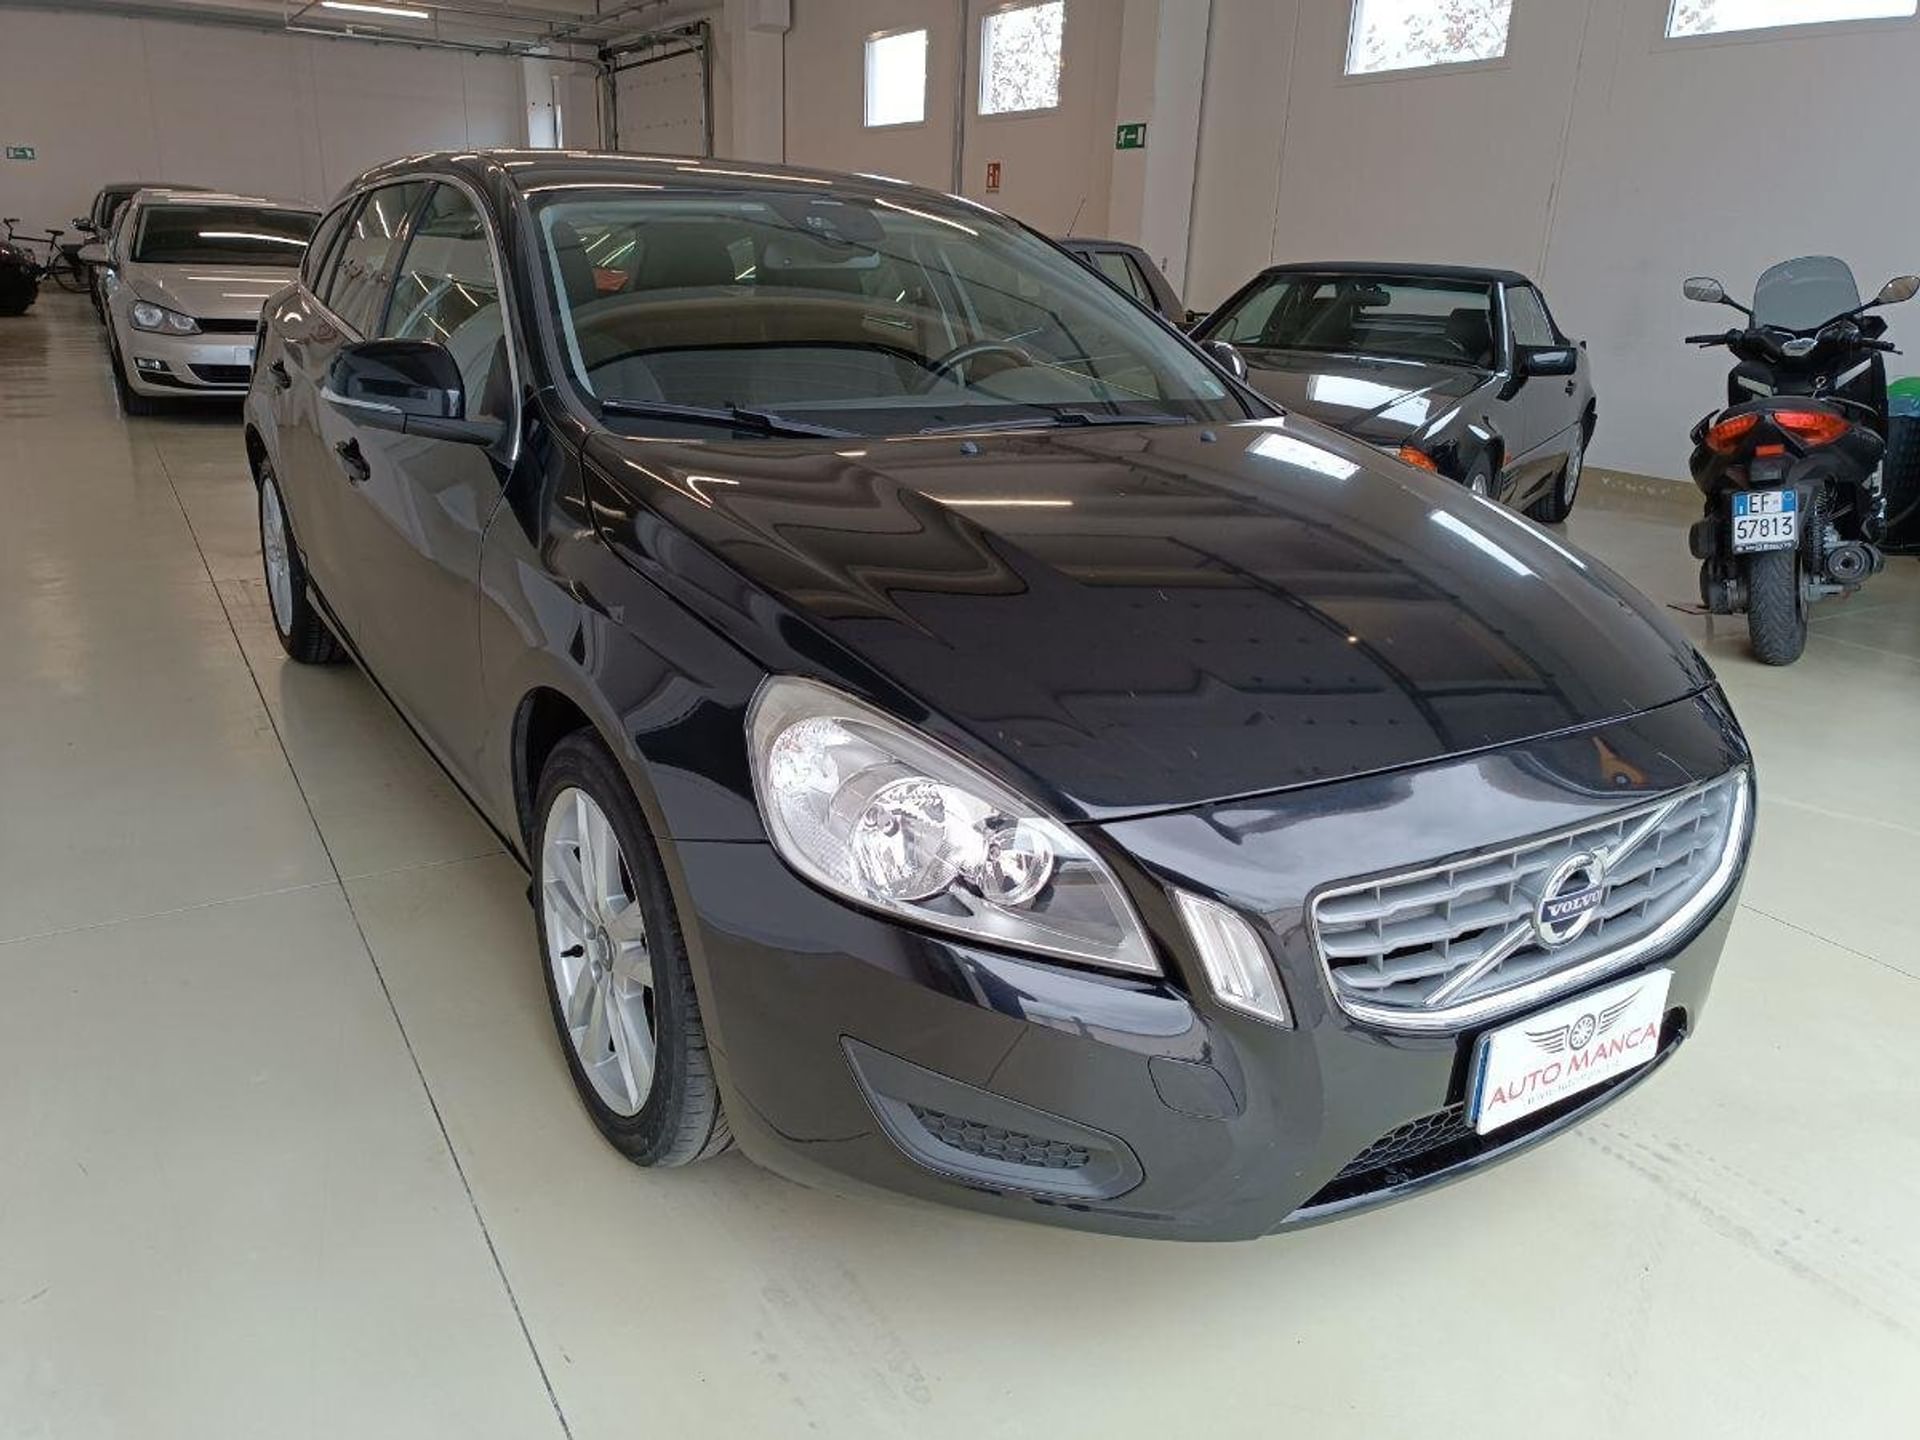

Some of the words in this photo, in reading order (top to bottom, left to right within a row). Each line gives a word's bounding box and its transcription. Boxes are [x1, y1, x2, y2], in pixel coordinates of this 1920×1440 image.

[1736, 516, 1793, 539] 57813
[1547, 889, 1602, 917] VOLVO
[1488, 1062, 1562, 1110] AUTO
[1567, 1022, 1657, 1077] MANCA
